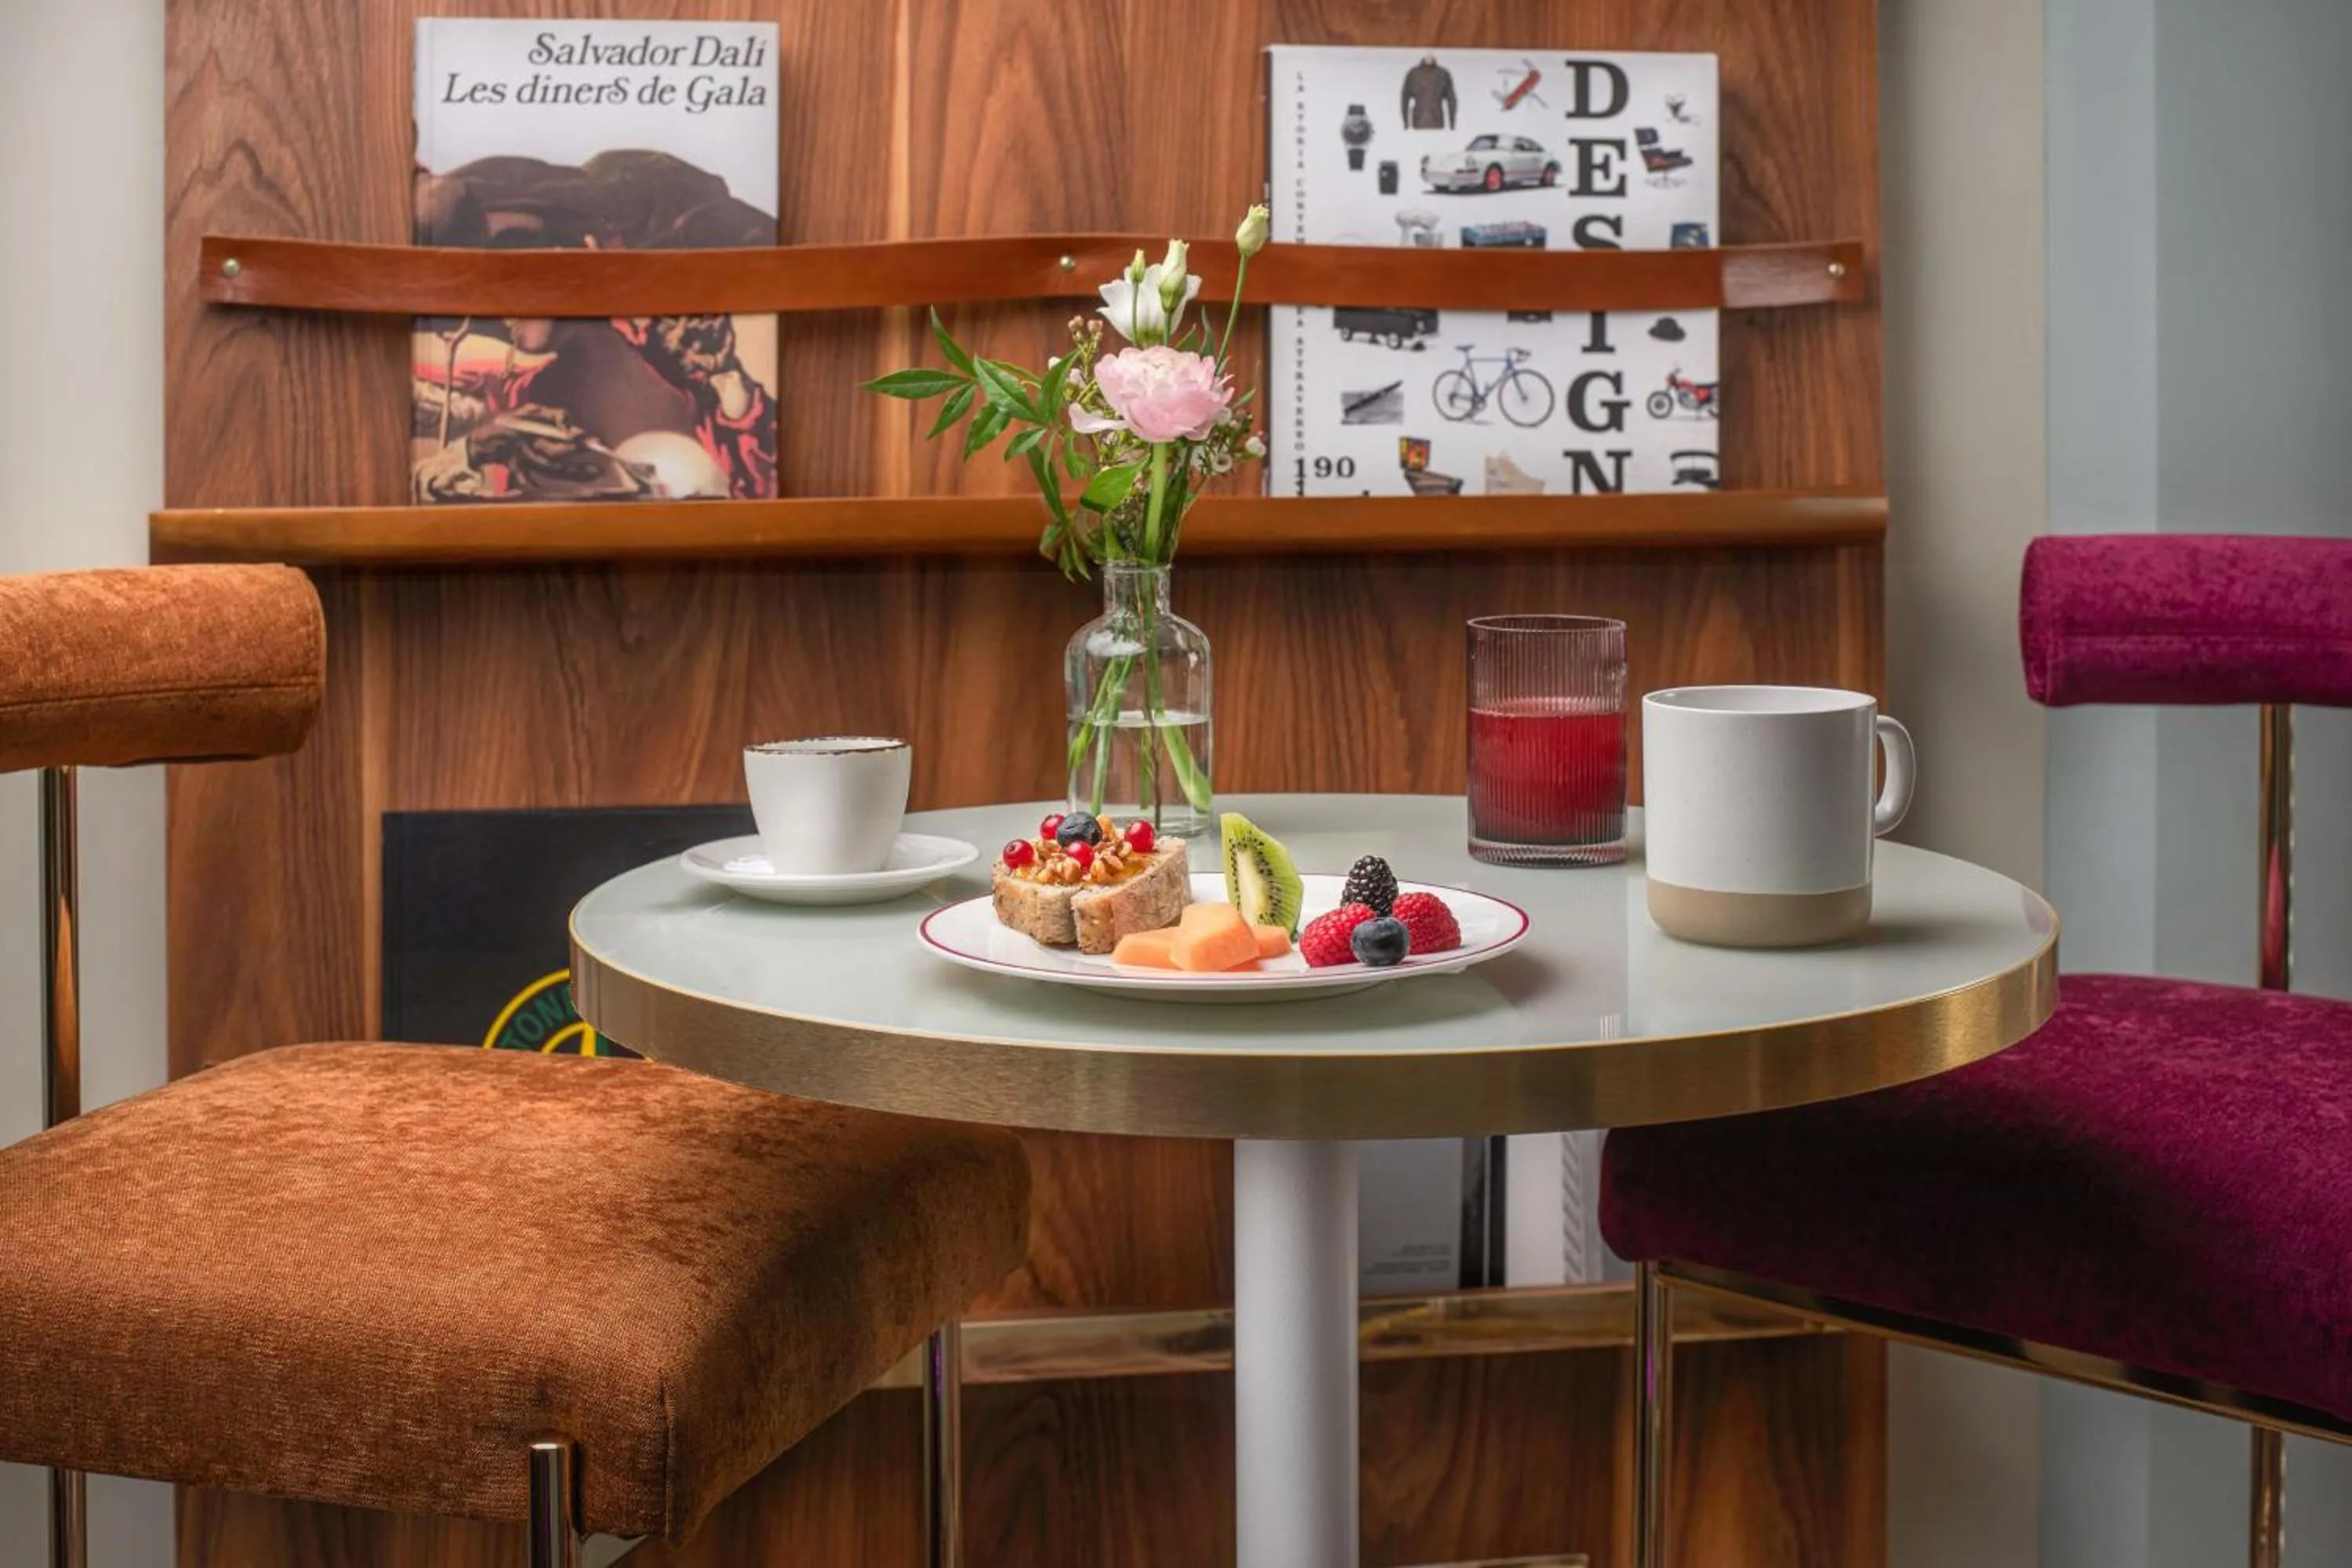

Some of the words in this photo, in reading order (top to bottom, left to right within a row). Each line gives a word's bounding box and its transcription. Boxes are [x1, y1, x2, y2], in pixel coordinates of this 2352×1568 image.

[528, 32, 688, 67] Salvador
[690, 34, 768, 68] Dalí
[441, 72, 507, 104] Les
[637, 74, 677, 107] de
[684, 74, 768, 114] Gala
